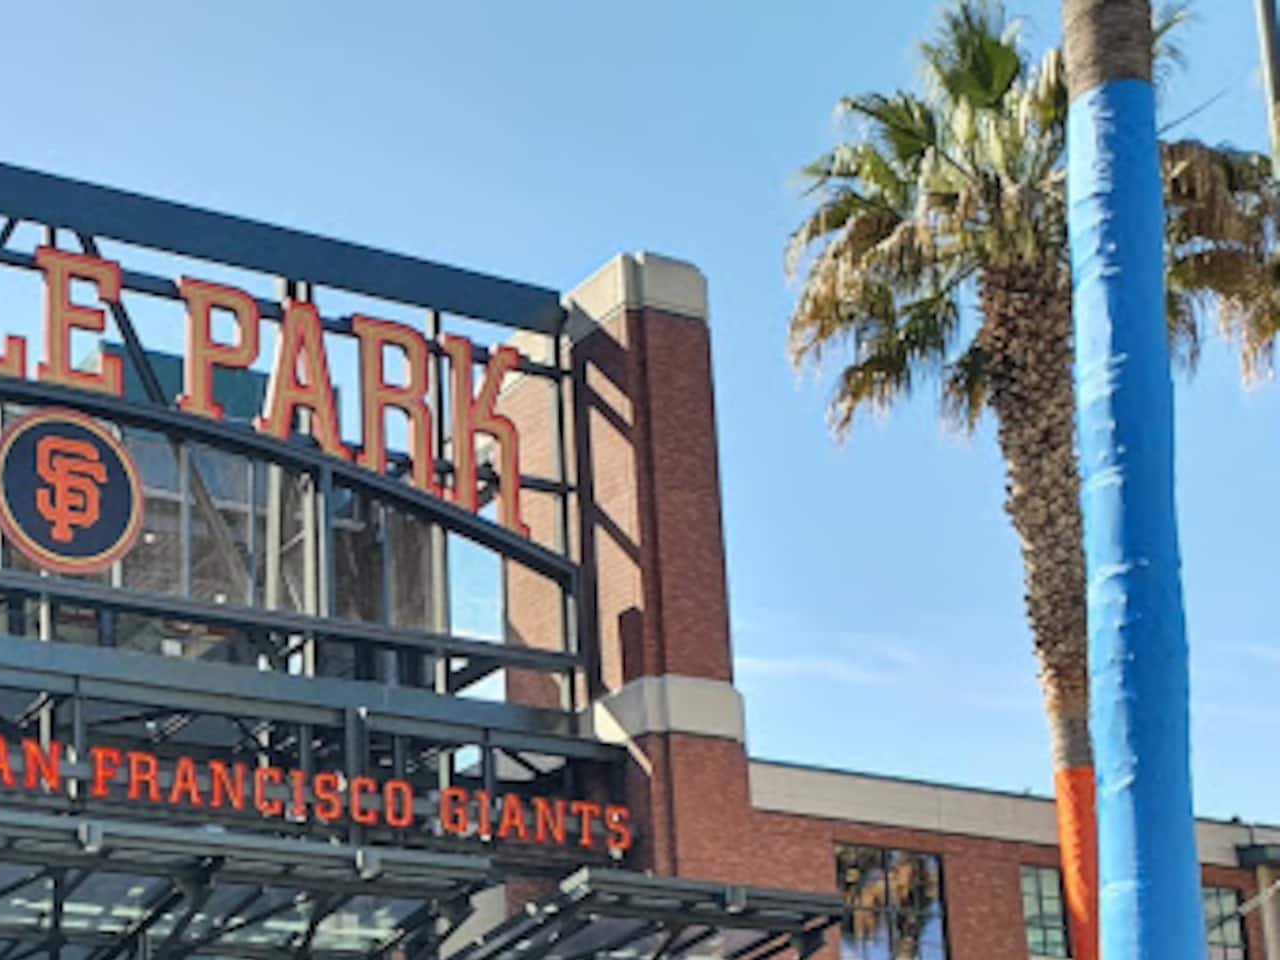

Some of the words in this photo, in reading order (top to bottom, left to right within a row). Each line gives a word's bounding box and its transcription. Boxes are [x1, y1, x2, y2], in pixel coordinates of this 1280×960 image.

[176, 275, 531, 538] PARK
[89, 744, 414, 829] FRANCISCO
[438, 786, 634, 852] GIANTS
